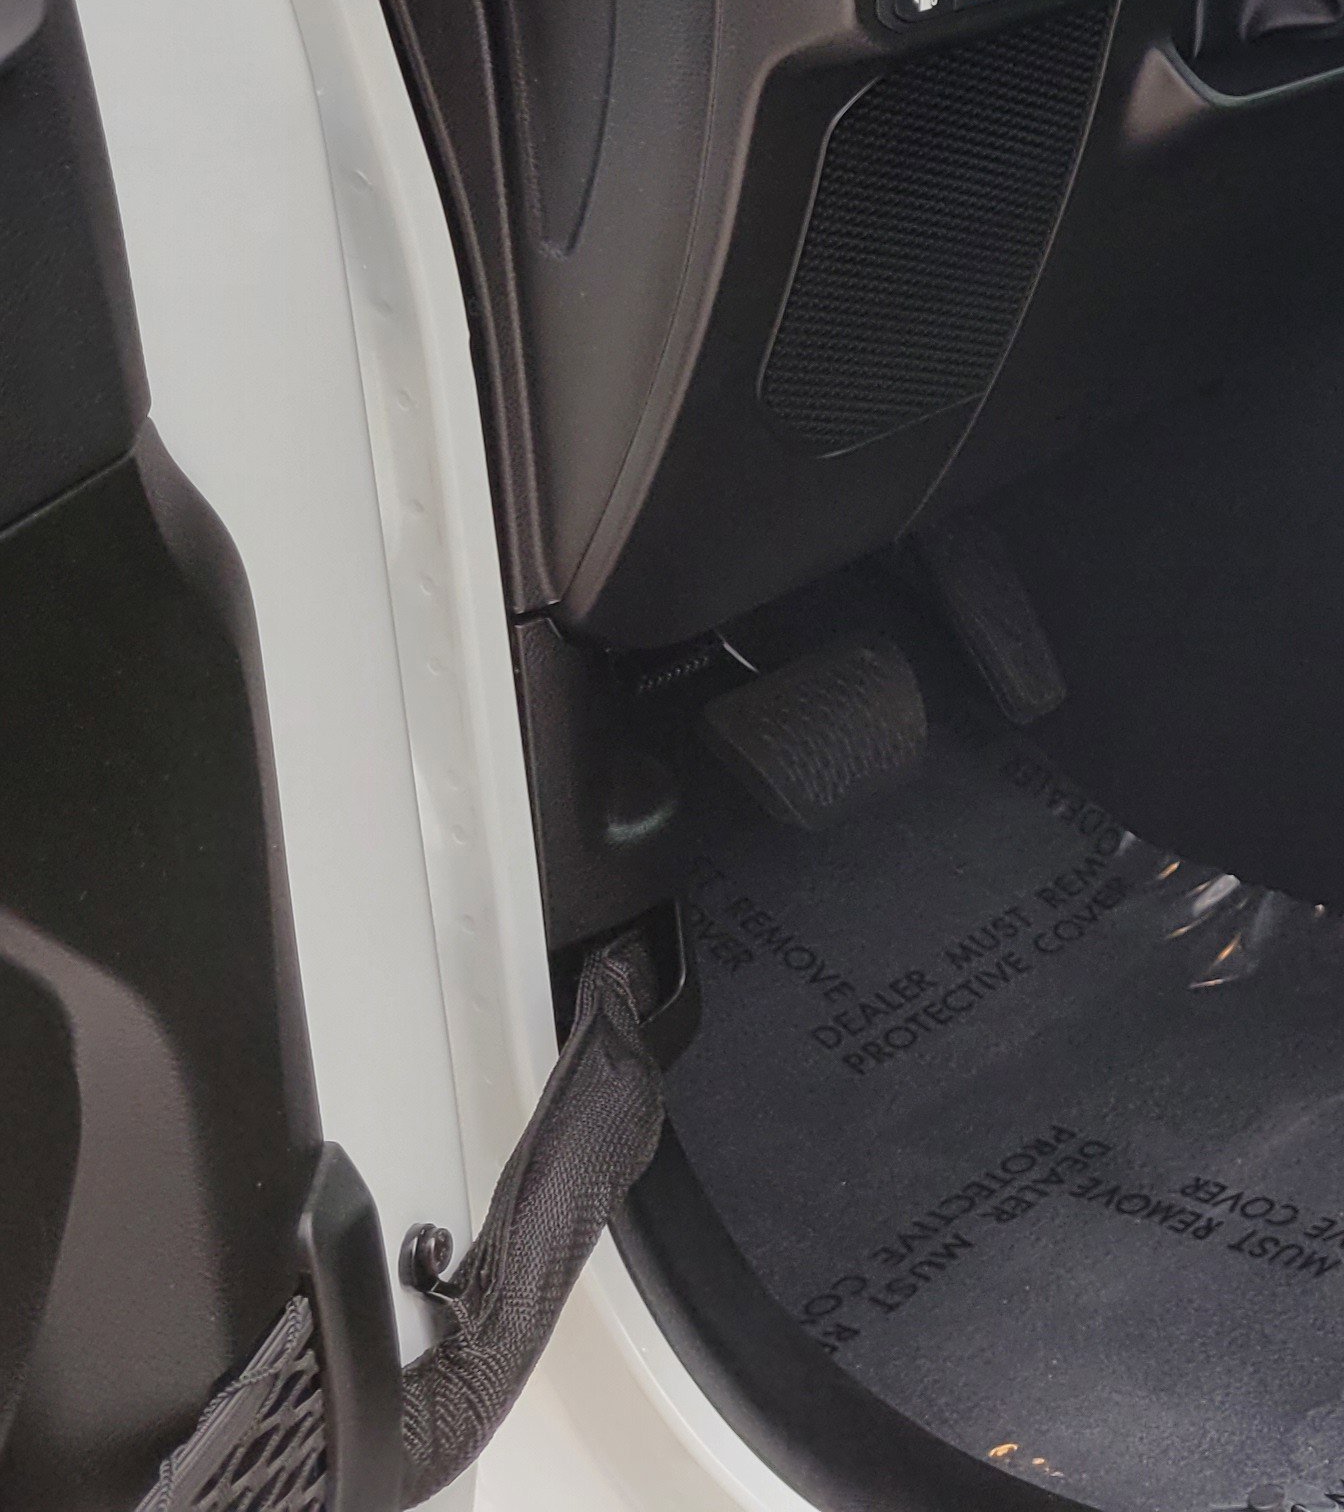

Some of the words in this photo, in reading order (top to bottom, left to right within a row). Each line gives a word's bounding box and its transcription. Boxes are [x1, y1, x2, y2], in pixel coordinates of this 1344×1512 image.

[724, 896, 857, 1004] REMOVE
[809, 968, 938, 1051] DEALER
[943, 906, 1033, 972] MUST
[842, 950, 1034, 1077] PROTECTIVE
[868, 1124, 1078, 1268] PROTECTIVE
[979, 1139, 1113, 1226] DEALER
[1069, 1176, 1224, 1242] REMOVE
[1179, 1176, 1300, 1228] COVER
[867, 1232, 976, 1316] MUST
[1226, 1229, 1342, 1279] MUST
